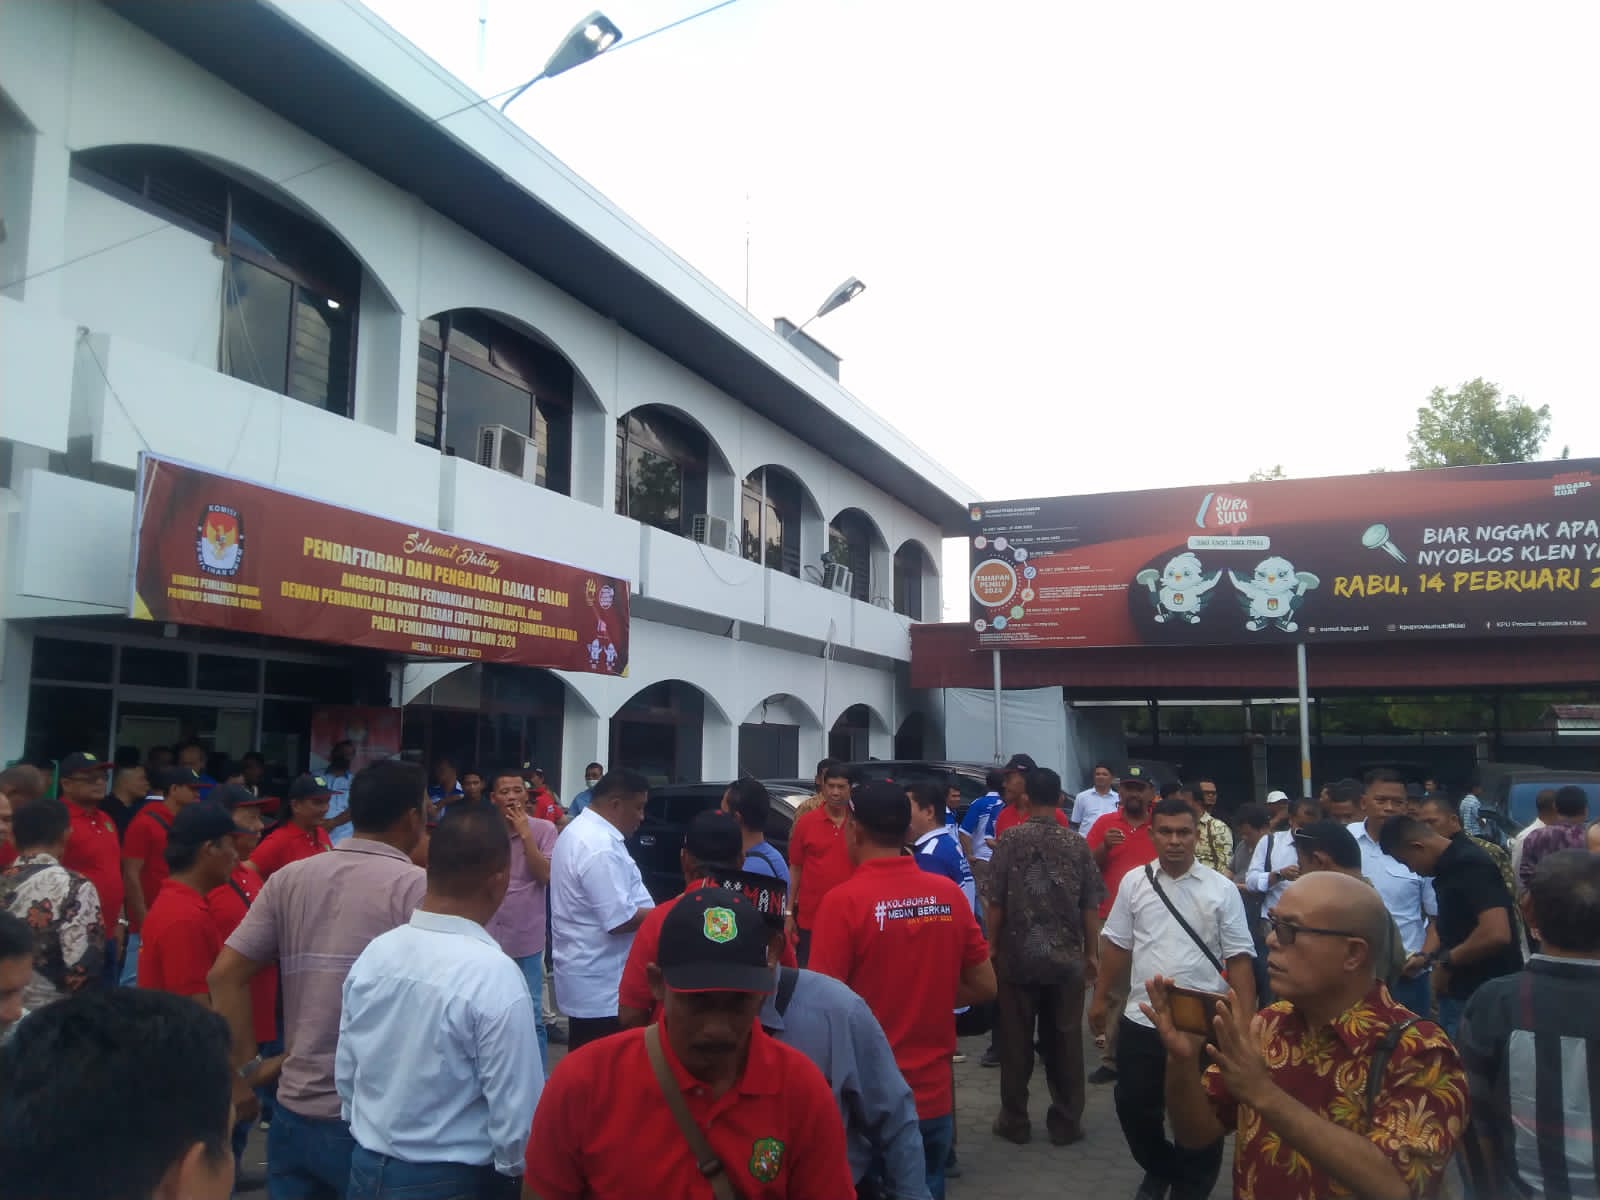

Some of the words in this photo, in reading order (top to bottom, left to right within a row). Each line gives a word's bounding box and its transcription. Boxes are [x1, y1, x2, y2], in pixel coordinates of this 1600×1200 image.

[1554, 481, 1592, 490] NEGARA
[1216, 496, 1248, 512] SURA
[1217, 511, 1247, 525] SULU
[1423, 526, 1471, 544] BIAR
[1476, 522, 1550, 542] NGGAK
[1556, 520, 1599, 539] APA
[403, 531, 459, 559] Selamat
[456, 548, 501, 574] Datang
[1418, 546, 1514, 566] NYOBLOS
[1520, 544, 1577, 561] KLEN
[303, 537, 403, 575] PENDAFTARAN
[405, 559, 432, 580] DAN
[434, 566, 500, 594] PENGAJUAN
[502, 580, 535, 601] BAKAL
[537, 587, 569, 608] CALON
[976, 574, 1010, 582] TAHAPAN
[1333, 574, 1408, 598] RABU,
[1419, 572, 1446, 593] 14
[1453, 567, 1581, 593] PEBRUARI
[341, 573, 386, 594] ANGGOTA
[388, 581, 420, 600] DEWAN
[421, 587, 473, 609] PERWAKILAN
[474, 597, 504, 614] DAERAH
[281, 581, 320, 602] DEWAN
[321, 588, 385, 612] PERWAKILAN
[386, 599, 419, 617] RAKYAT
[420, 605, 453, 623] DAERAH
[483, 615, 518, 633] PROVINSI
[519, 621, 556, 638] SUMATERA
[556, 627, 578, 642] UTARA
[371, 615, 396, 632] PADA
[397, 619, 443, 638] PEMILIHAN
[444, 627, 471, 642] UMUM
[472, 630, 496, 646] TAHUN
[497, 633, 516, 649] 2024
[888, 908, 914, 919] MEDAN
[917, 905, 951, 917] BERKAH
